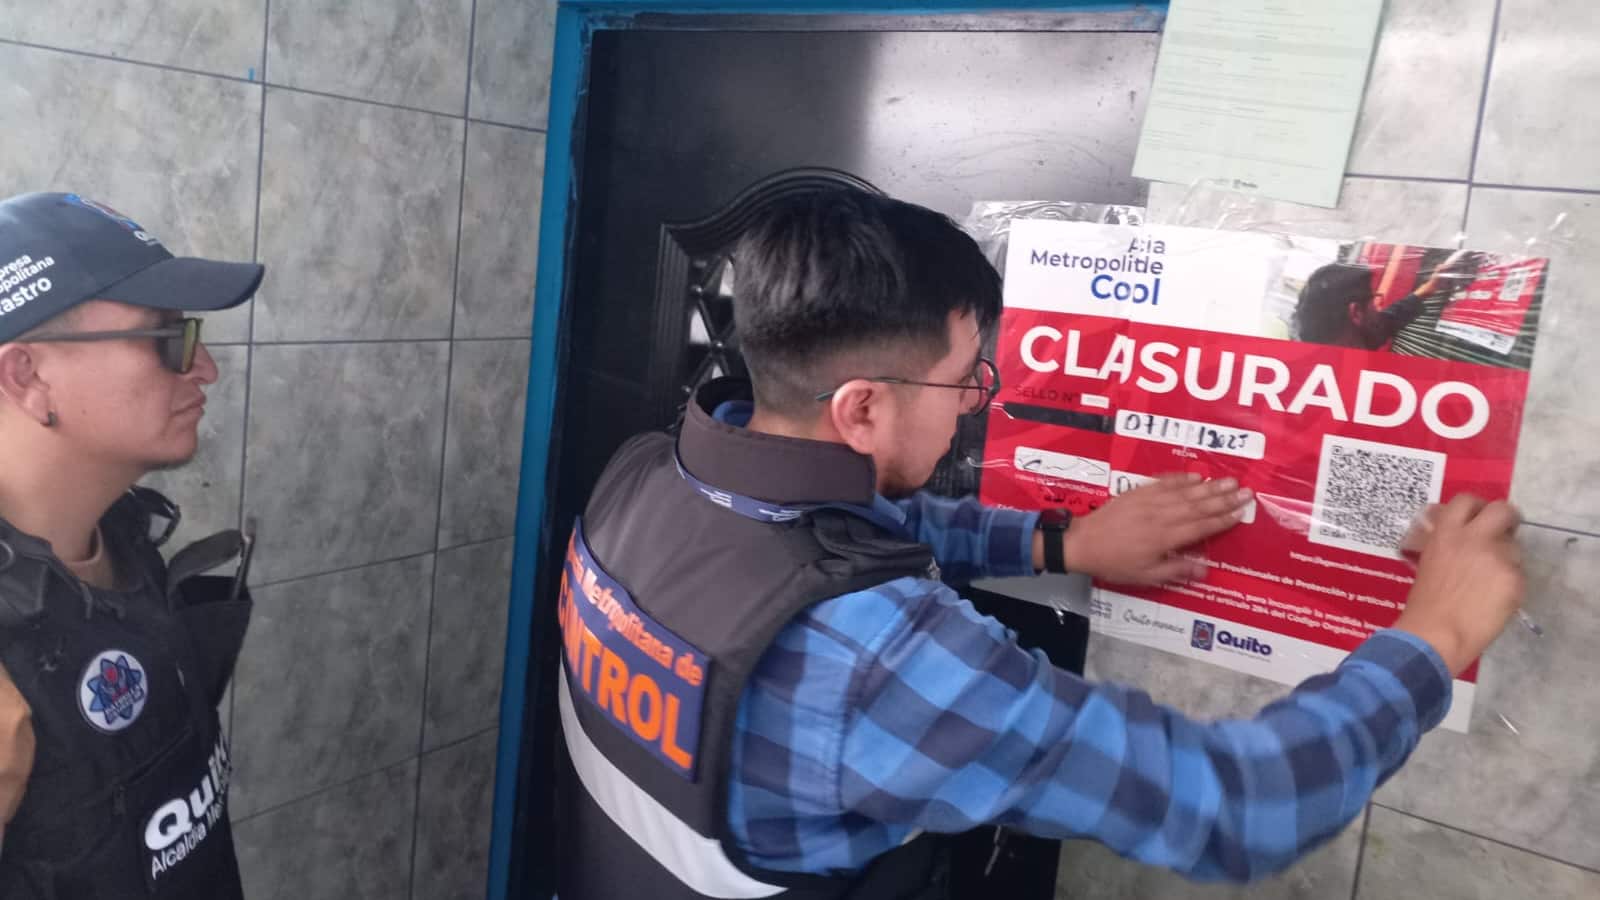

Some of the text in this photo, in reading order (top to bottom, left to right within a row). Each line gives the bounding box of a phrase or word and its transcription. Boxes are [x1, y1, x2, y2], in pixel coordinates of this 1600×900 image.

[1020, 325, 1491, 440] CLASURADO
[1216, 630, 1273, 656] Quito
[675, 652, 704, 687] de
